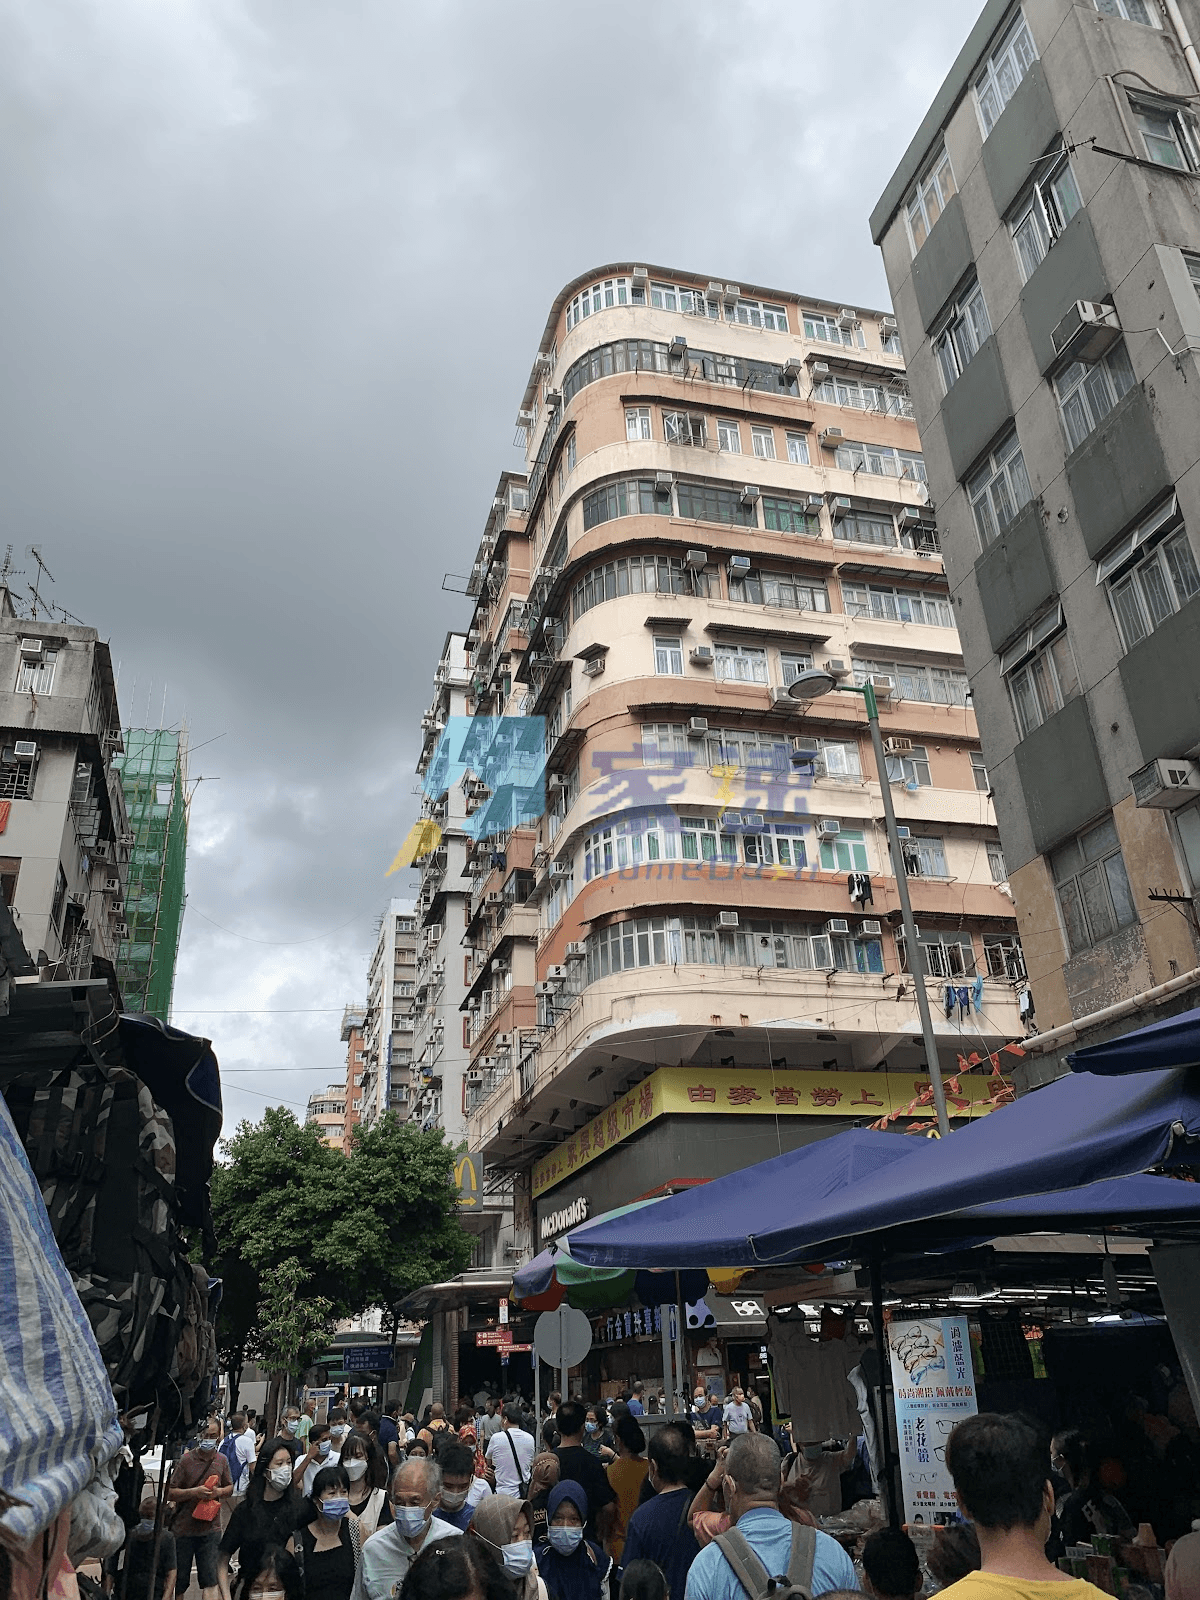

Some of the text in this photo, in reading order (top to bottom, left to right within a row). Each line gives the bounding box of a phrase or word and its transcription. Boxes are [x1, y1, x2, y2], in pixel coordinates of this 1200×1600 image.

[686, 1083, 884, 1108] 由麥當勞上
[541, 1196, 588, 1239] McDonald's
[949, 1326, 966, 1380] 過濾藍光
[914, 1416, 931, 1463] 老花鏡
